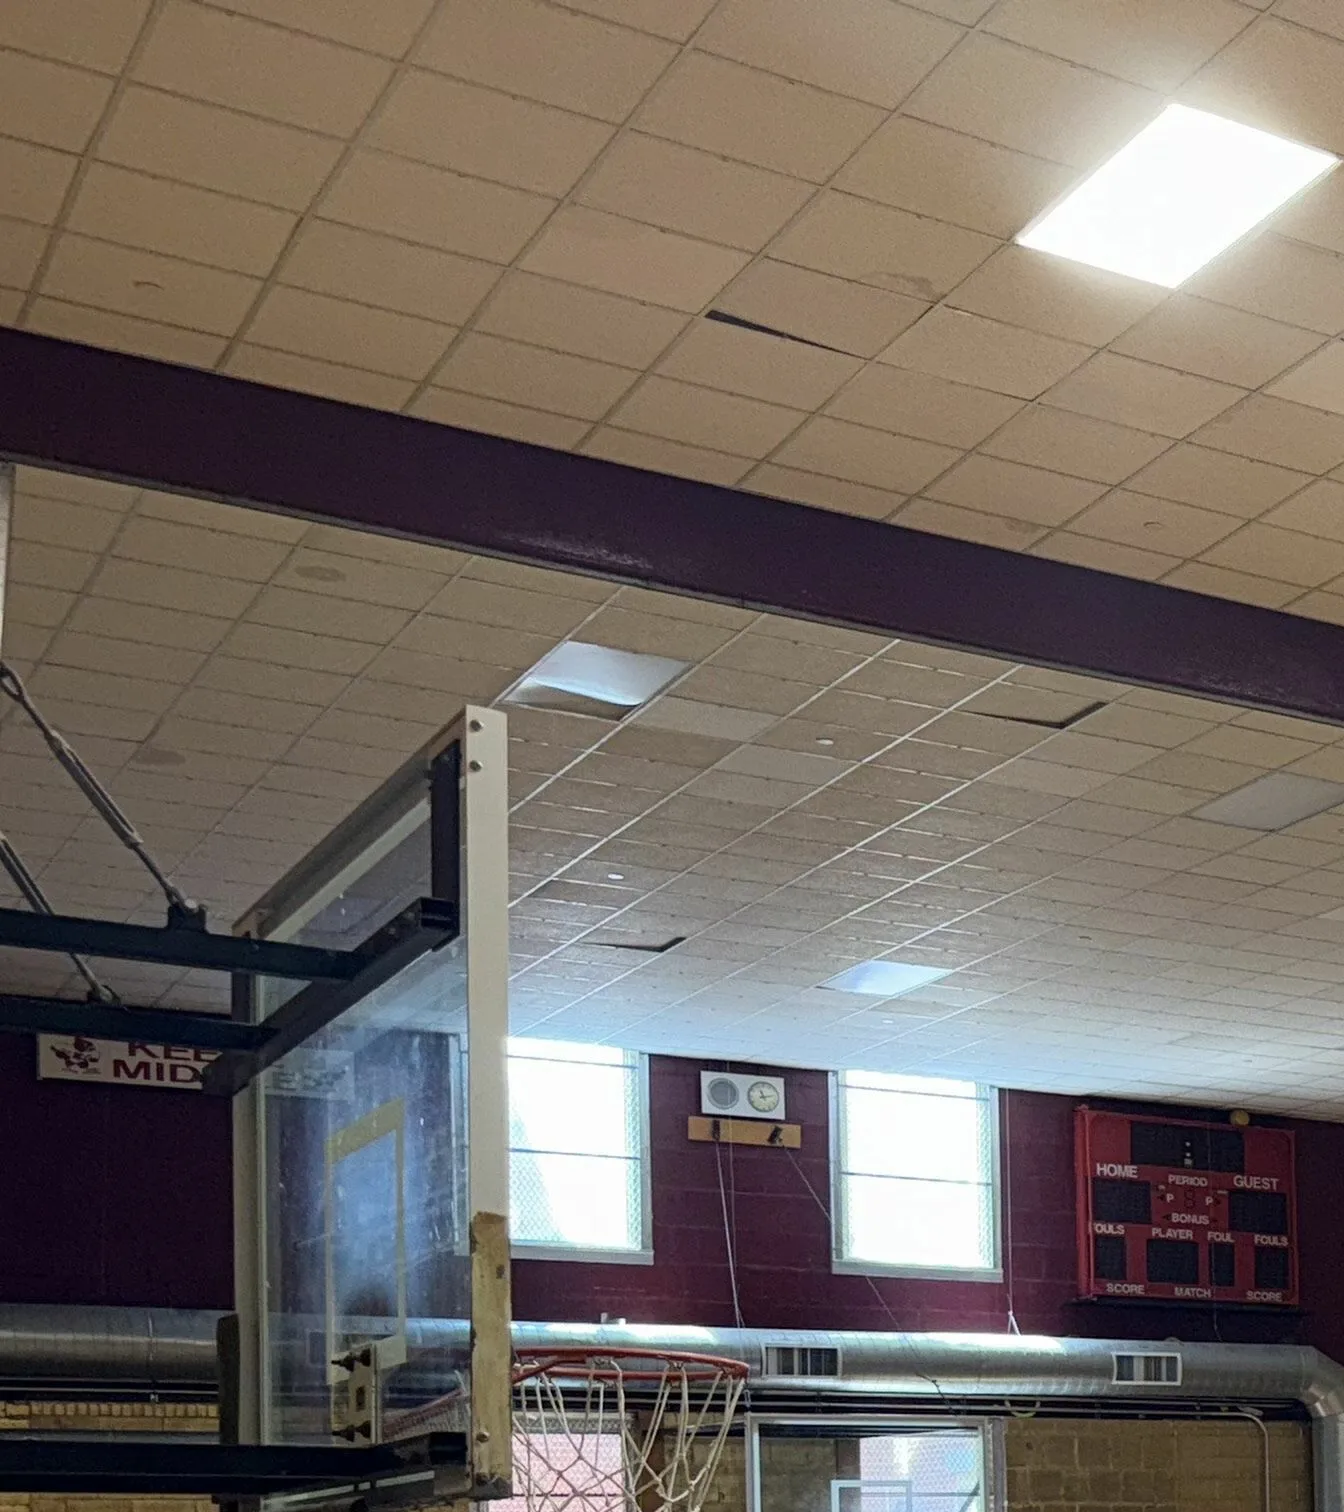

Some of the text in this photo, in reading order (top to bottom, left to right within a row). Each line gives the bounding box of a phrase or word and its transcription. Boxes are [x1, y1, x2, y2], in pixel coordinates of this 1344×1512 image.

[1096, 1163, 1138, 1179] HOME
[1168, 1174, 1208, 1187] PERIOD
[1233, 1174, 1279, 1191] GUEST
[1171, 1212, 1210, 1225] BONUS
[1093, 1223, 1125, 1235] OULS
[1151, 1227, 1193, 1240] PLAYER
[1207, 1231, 1235, 1243] FOUL
[1254, 1234, 1288, 1247] FOULS
[1106, 1282, 1145, 1295] SCORE
[1174, 1287, 1212, 1299] MATCH
[1247, 1290, 1283, 1303] SCORE
